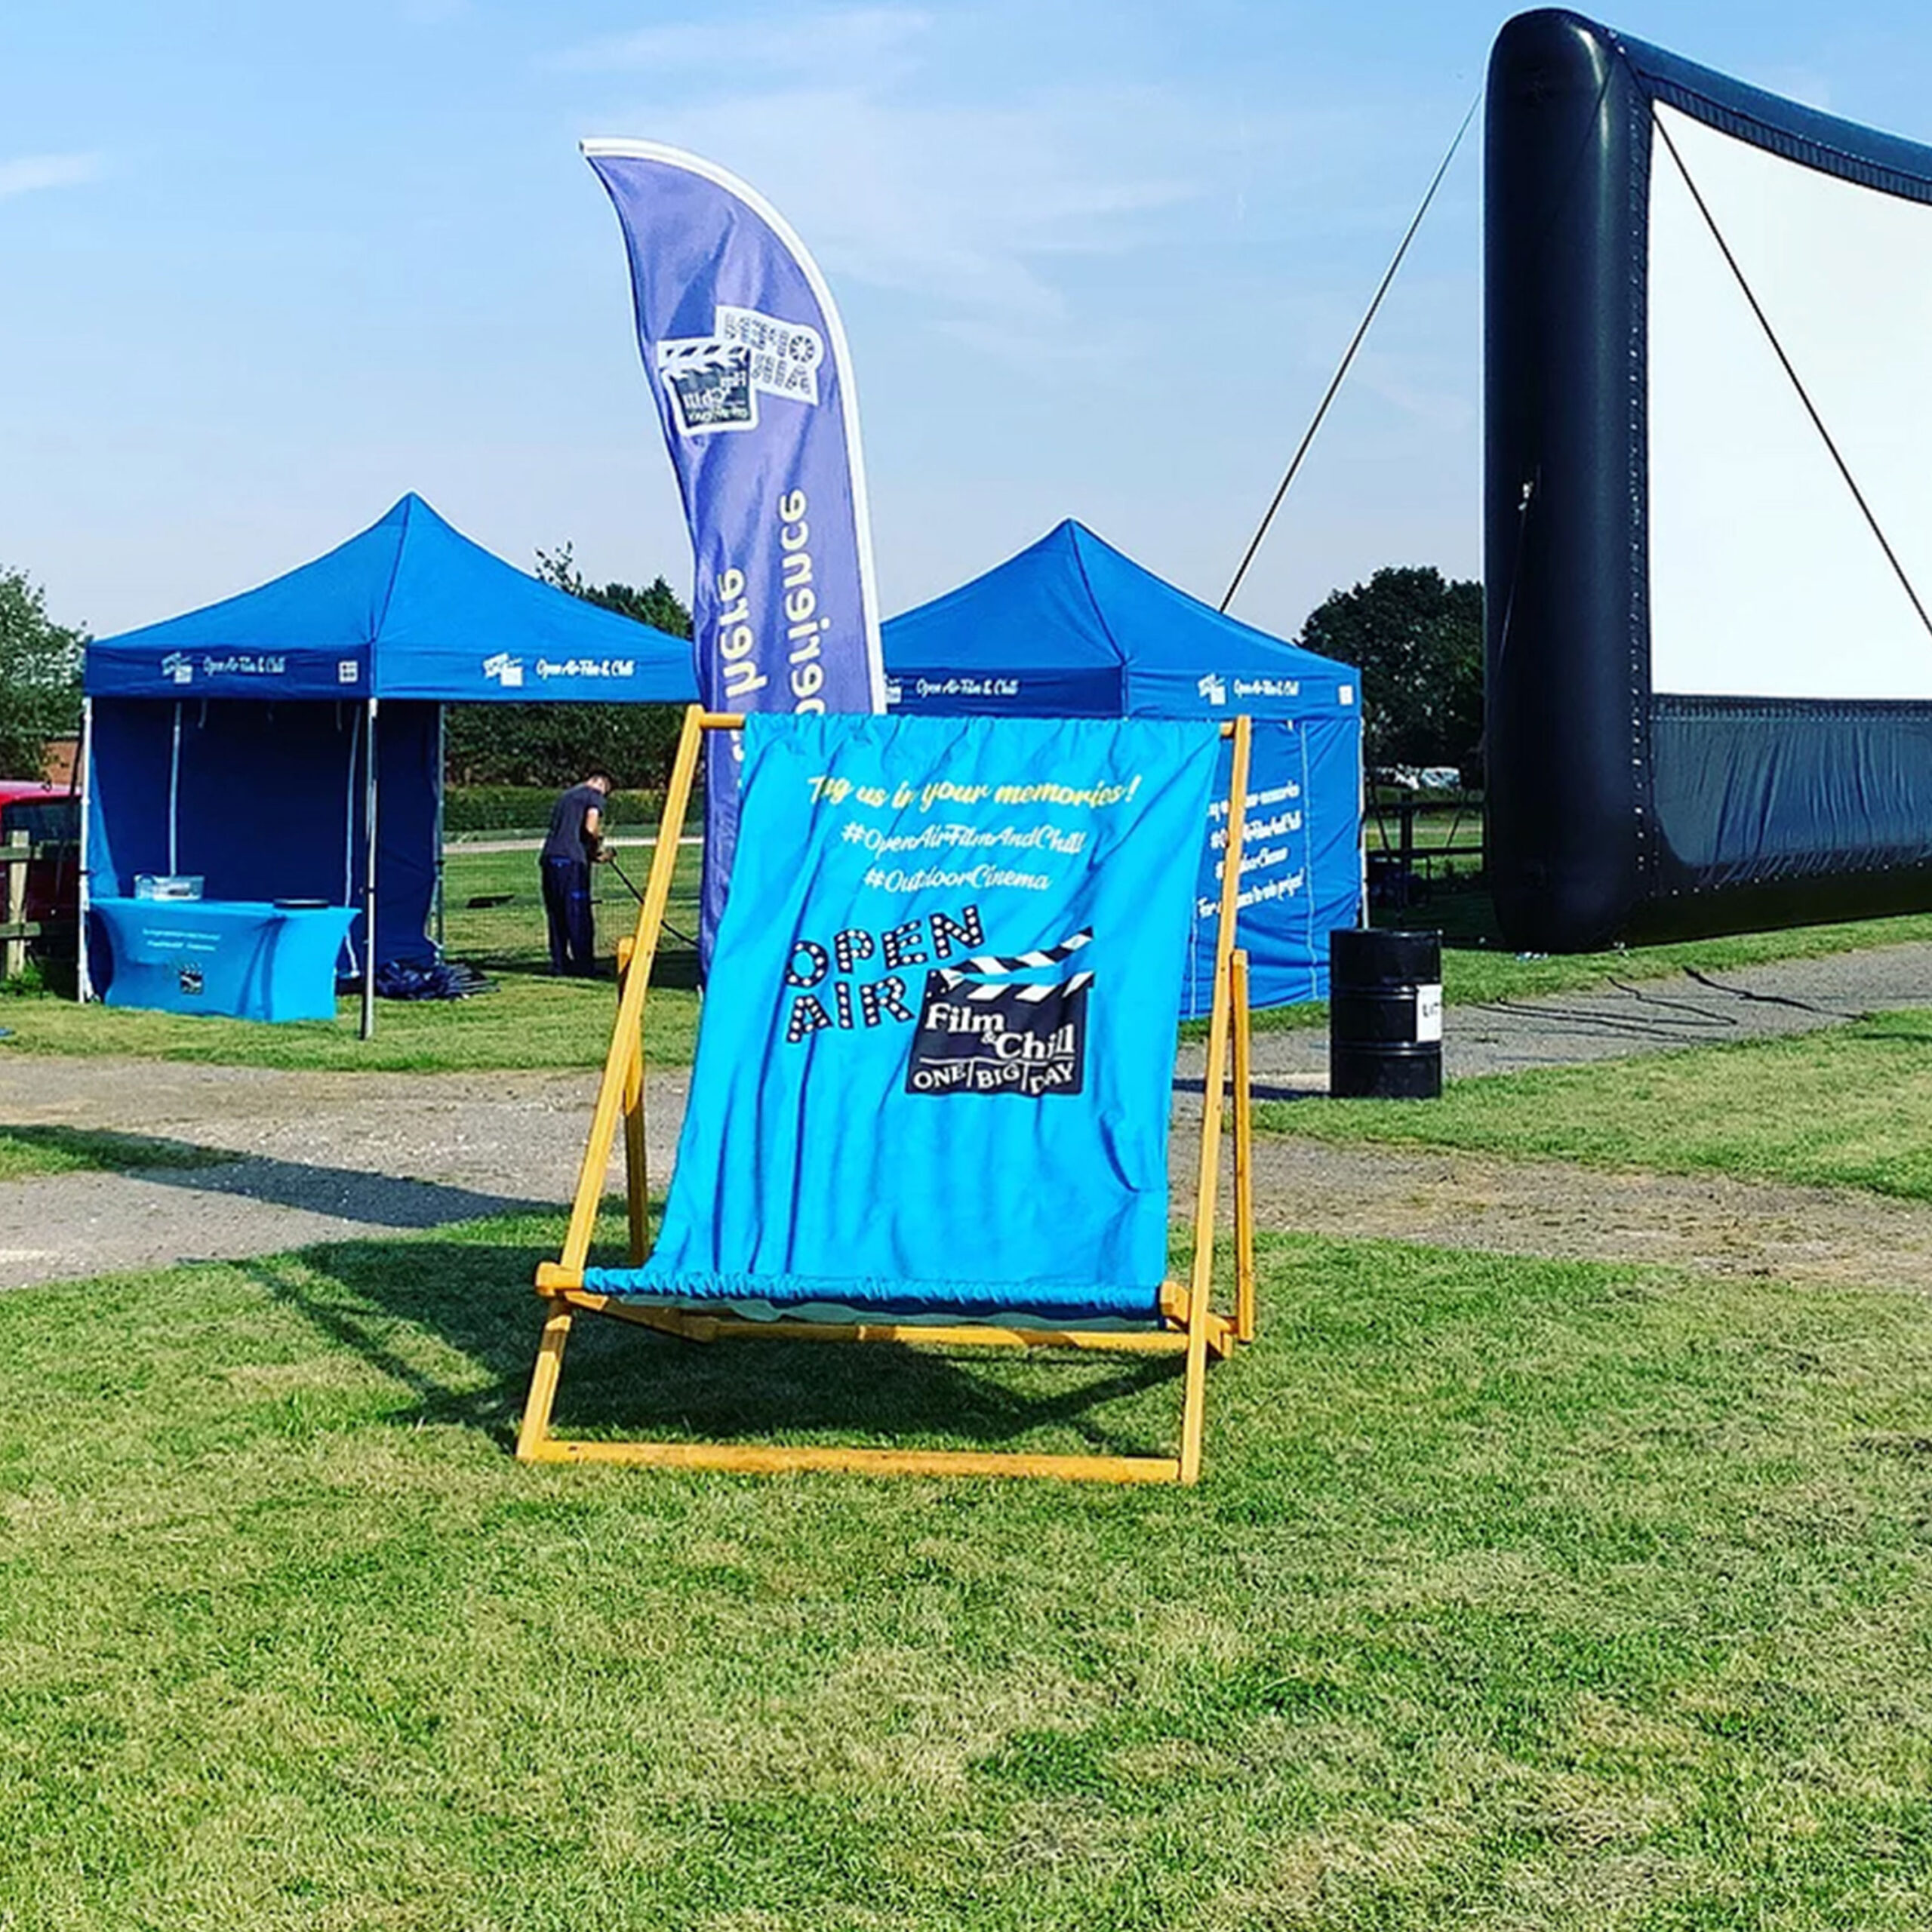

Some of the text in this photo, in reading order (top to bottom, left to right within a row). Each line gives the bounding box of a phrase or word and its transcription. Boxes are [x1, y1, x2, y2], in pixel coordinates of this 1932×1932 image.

[856, 785, 889, 808] us
[919, 781, 991, 813] your
[994, 775, 1142, 810] memories!
[841, 822, 1087, 860] #OpenAirFilmAndChill
[864, 864, 1054, 893] #OutdoorCinema
[785, 904, 985, 989] OPEN
[786, 975, 915, 1044] AIR
[924, 1001, 1004, 1033] Film
[981, 1024, 1075, 1060] & Chill
[913, 1062, 1075, 1094] ONE BIG DAY
